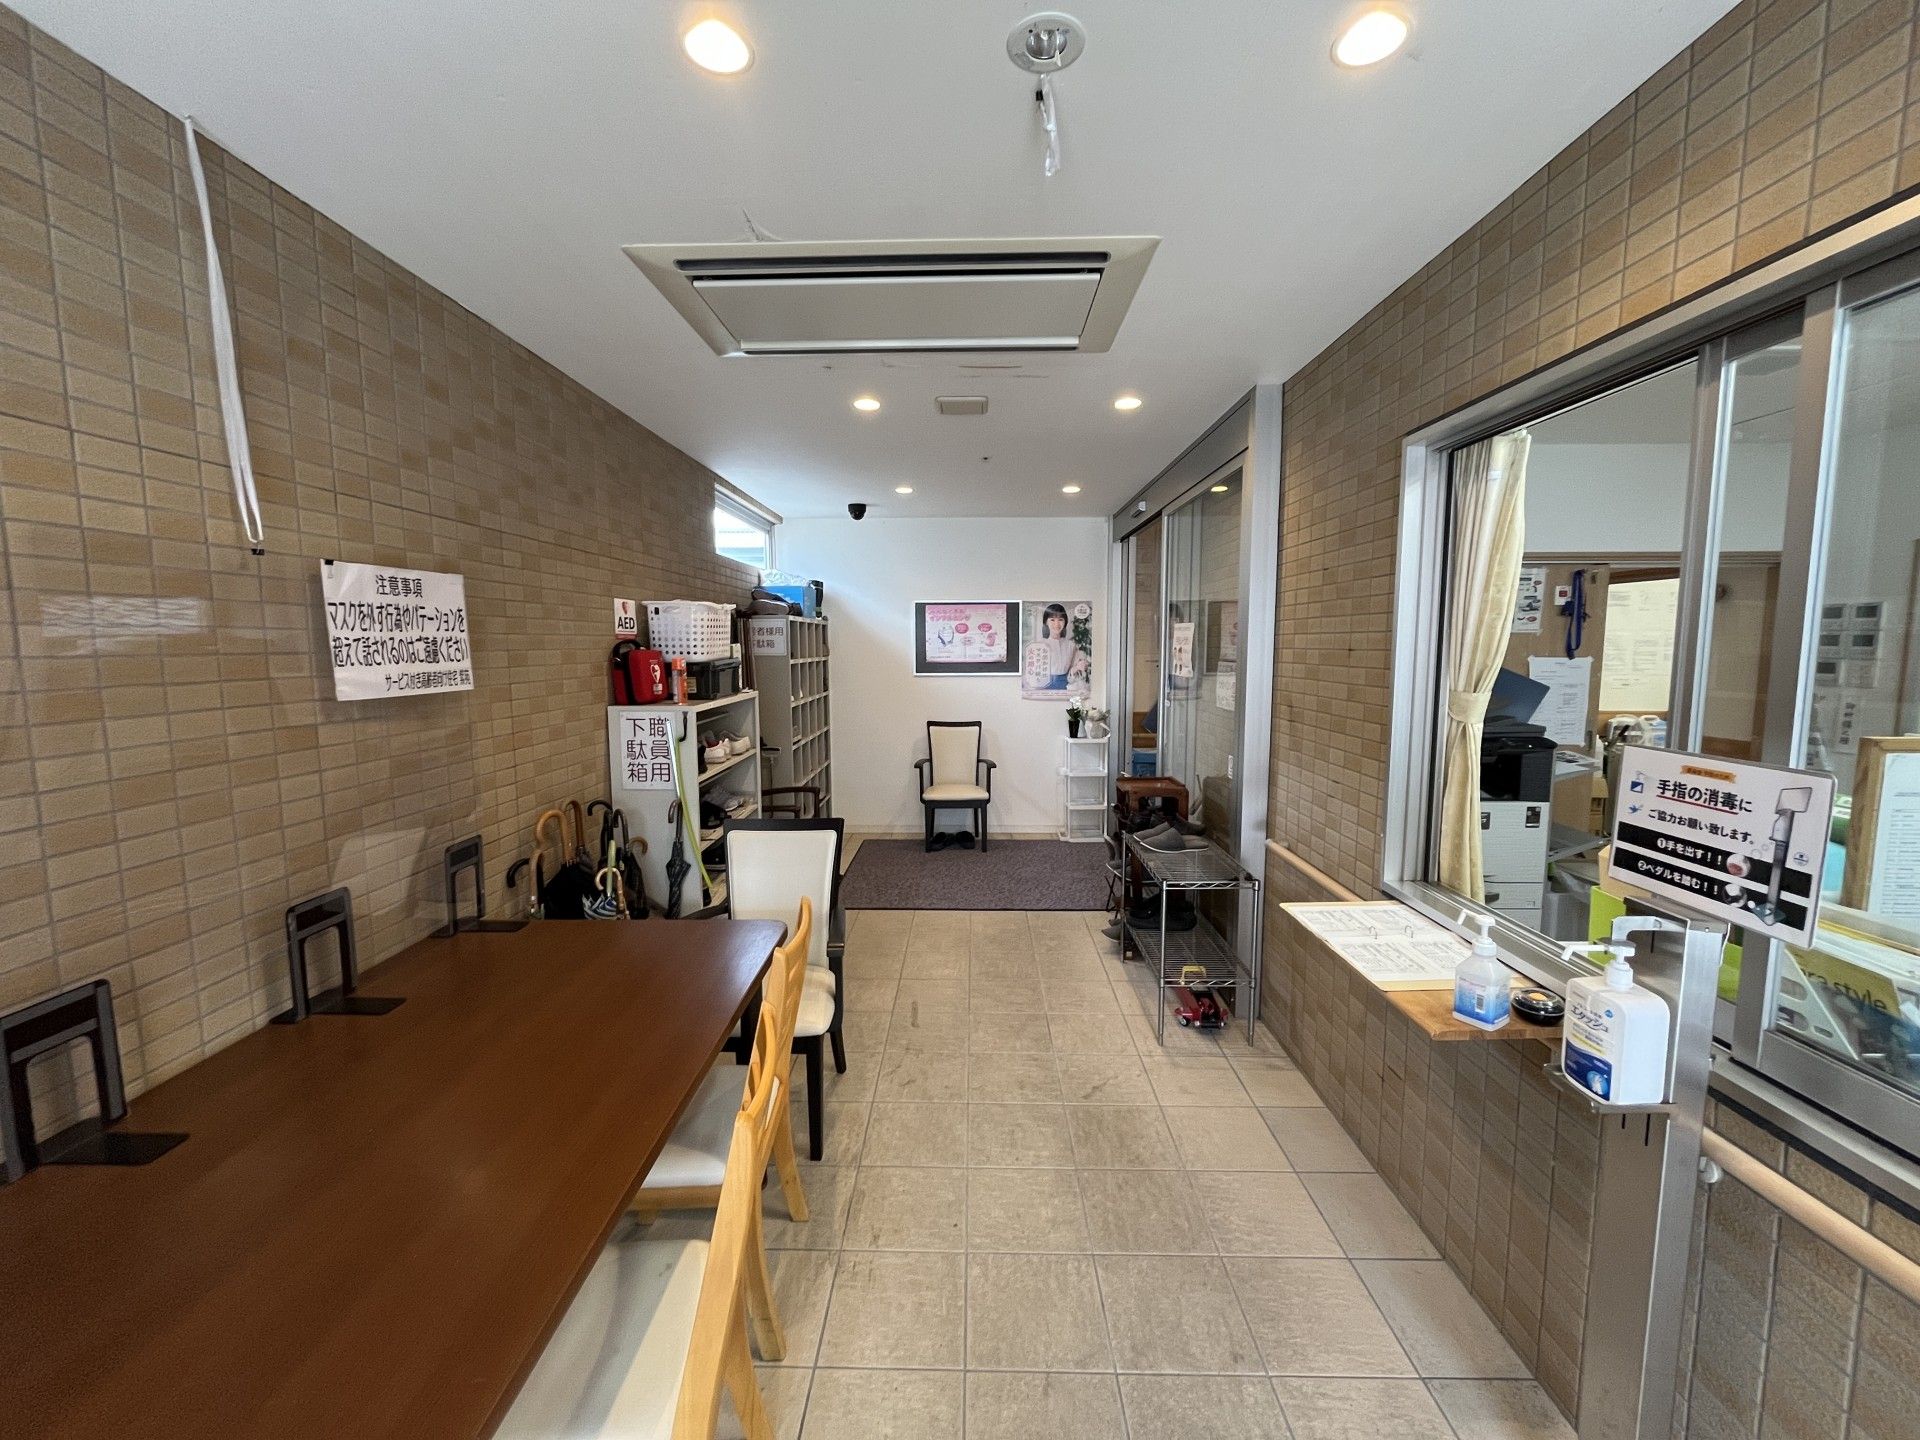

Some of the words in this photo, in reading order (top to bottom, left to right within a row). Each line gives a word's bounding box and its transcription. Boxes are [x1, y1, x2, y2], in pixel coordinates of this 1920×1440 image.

[375, 574, 423, 598] 注意事項
[327, 600, 466, 633] マスクを外す行為やパテーションを
[617, 616, 635, 630] AED
[332, 635, 469, 667] 超えて話されるのはご遠慮ください
[626, 717, 648, 783] 下駄箱
[649, 717, 671, 783] 職員用
[1656, 779, 1753, 813] 手指の消毒に
[1648, 809, 1754, 845] ご協力お願い致します。
